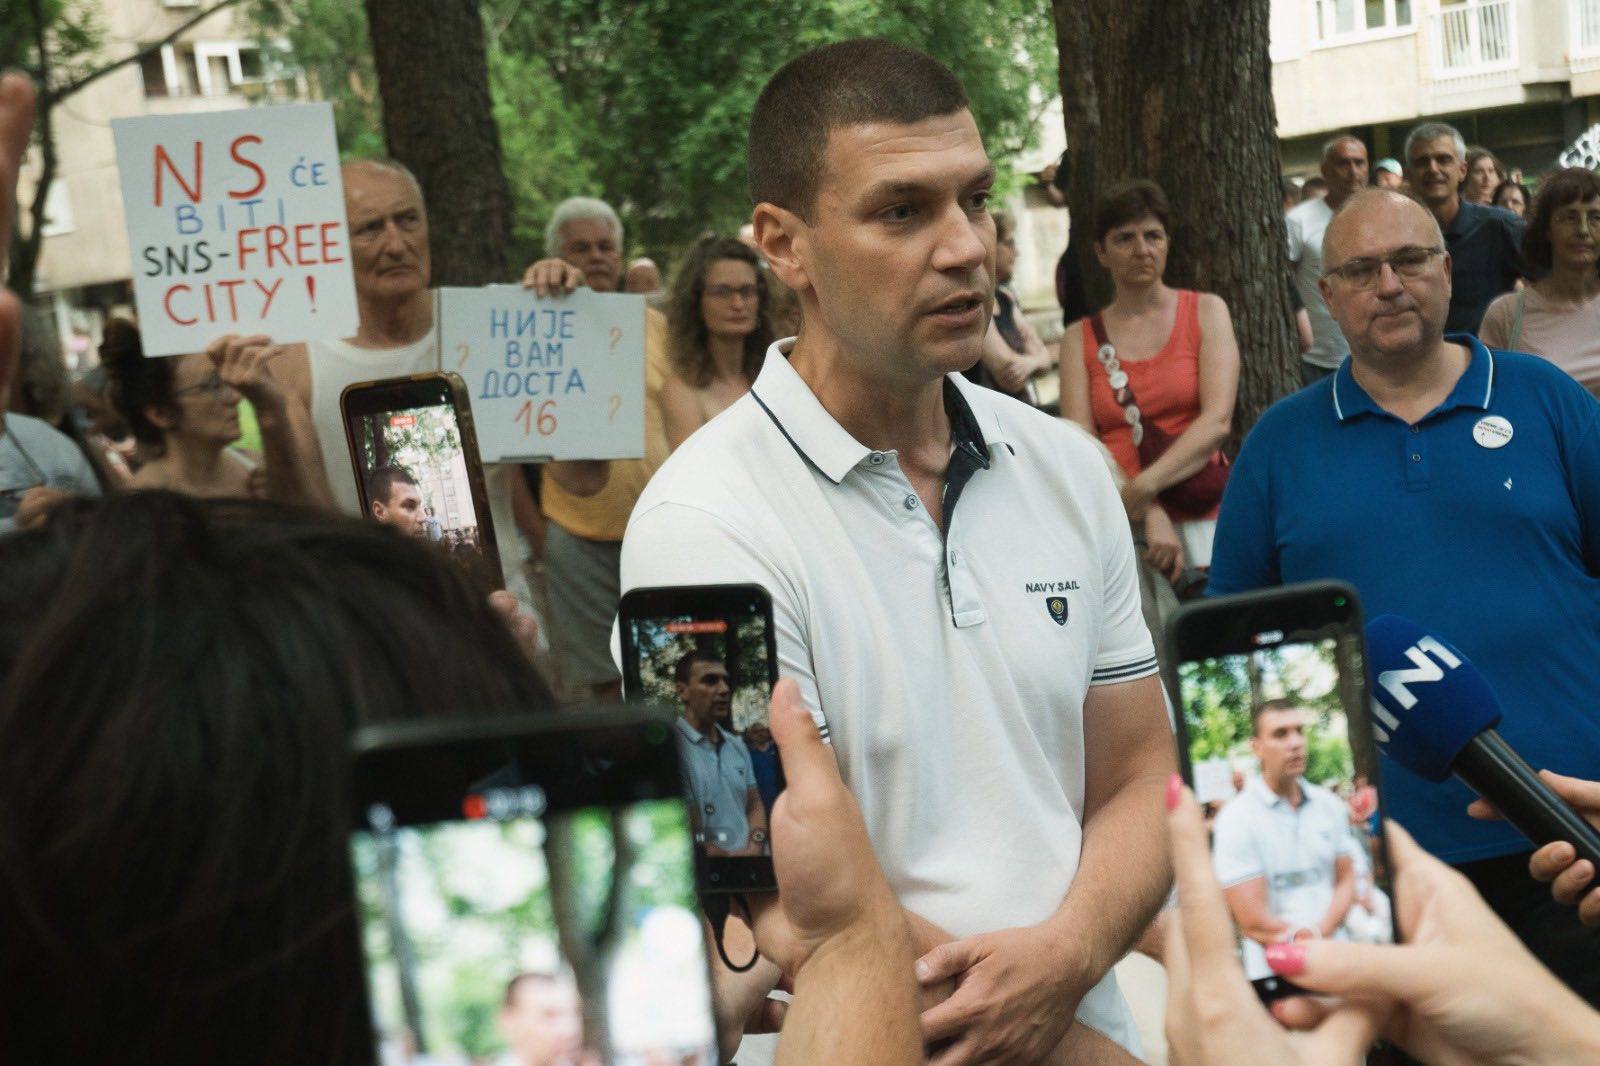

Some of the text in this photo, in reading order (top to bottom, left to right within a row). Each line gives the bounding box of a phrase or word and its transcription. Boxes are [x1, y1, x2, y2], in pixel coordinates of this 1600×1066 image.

[290, 156, 329, 188] ĆE
[175, 197, 286, 236] BITI
[490, 308, 577, 340] НИЈЕ
[505, 340, 565, 369] ВАМ
[478, 367, 587, 400] ДОСТА
[513, 399, 559, 437] 16
[1025, 580, 1081, 593] NAVY SAIL
[1378, 635, 1463, 711] N1
